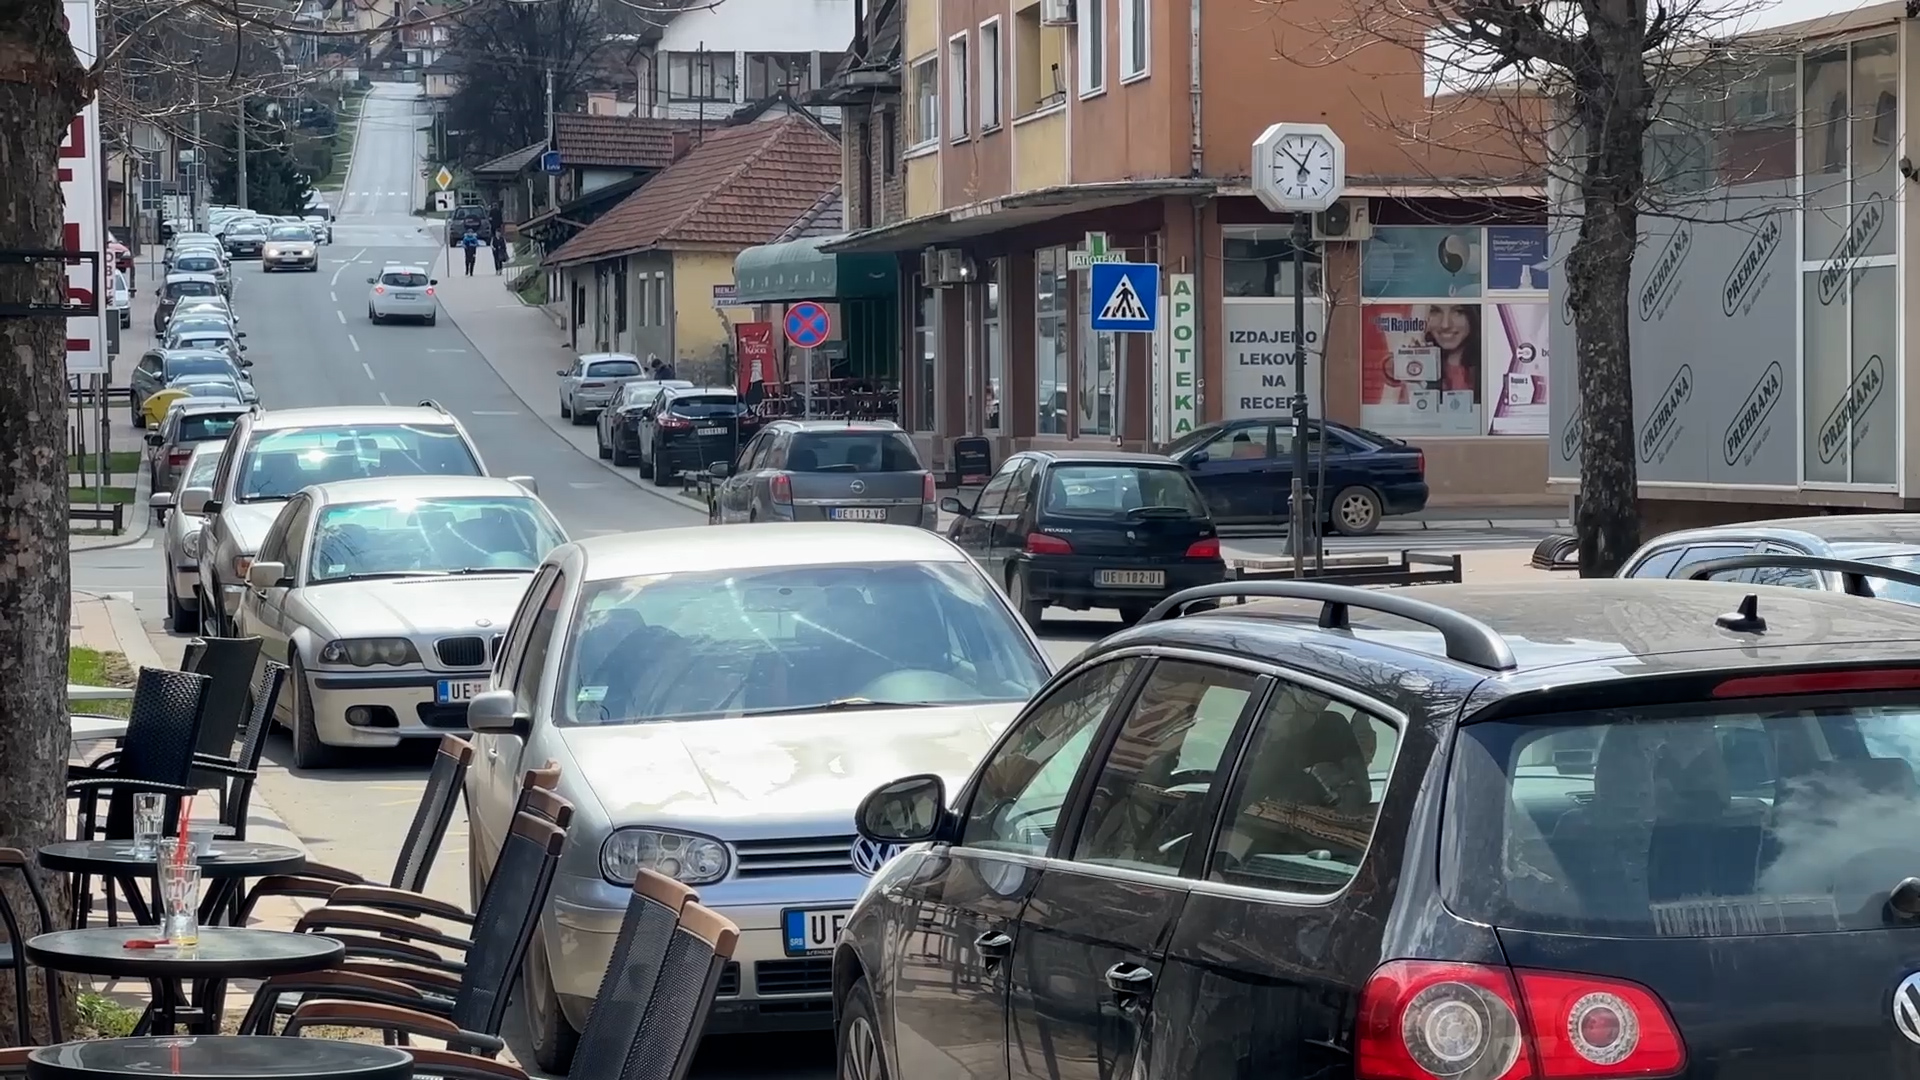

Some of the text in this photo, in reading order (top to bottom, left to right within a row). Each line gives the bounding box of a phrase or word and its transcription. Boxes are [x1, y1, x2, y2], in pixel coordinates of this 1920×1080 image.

[1642, 229, 1689, 313] PREHRANA
[1726, 220, 1777, 308] PREHRANA
[1823, 205, 1879, 296] PREHRANA
[1174, 280, 1193, 433] APOTEKA
[1230, 331, 1317, 343] IZDAJEO
[1240, 397, 1307, 409] RECEP
[1262, 375, 1286, 387] NA
[1642, 376, 1689, 453] PREHRANA
[1726, 374, 1778, 456] PREHRANA
[1823, 369, 1879, 455] PREHRANA
[1103, 571, 1116, 583] UE
[452, 683, 471, 700] UE
